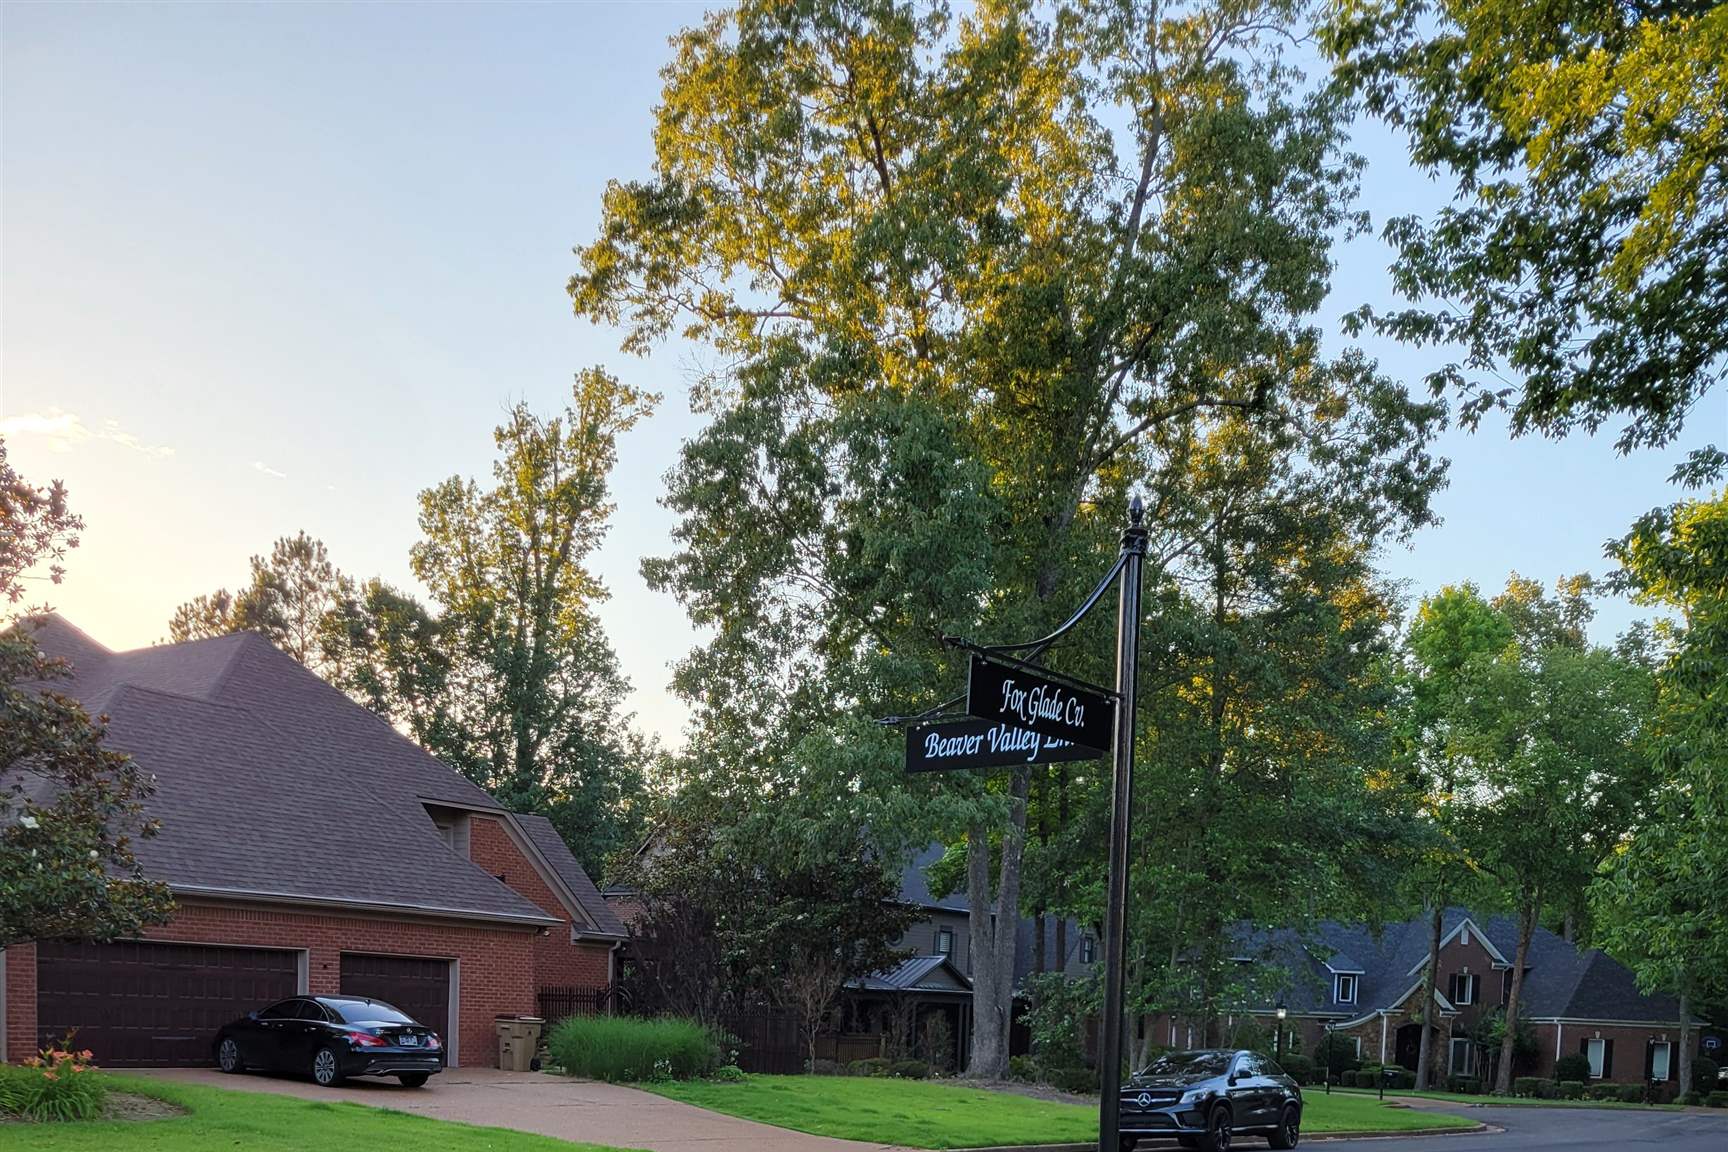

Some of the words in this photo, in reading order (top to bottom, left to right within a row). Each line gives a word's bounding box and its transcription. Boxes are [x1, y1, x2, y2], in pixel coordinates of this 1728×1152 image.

[1000, 679, 1027, 721] Fox
[1028, 684, 1063, 725] Glade
[1065, 697, 1085, 728] Cv.
[924, 731, 983, 758] Beaver
[987, 723, 1041, 761] Valley
